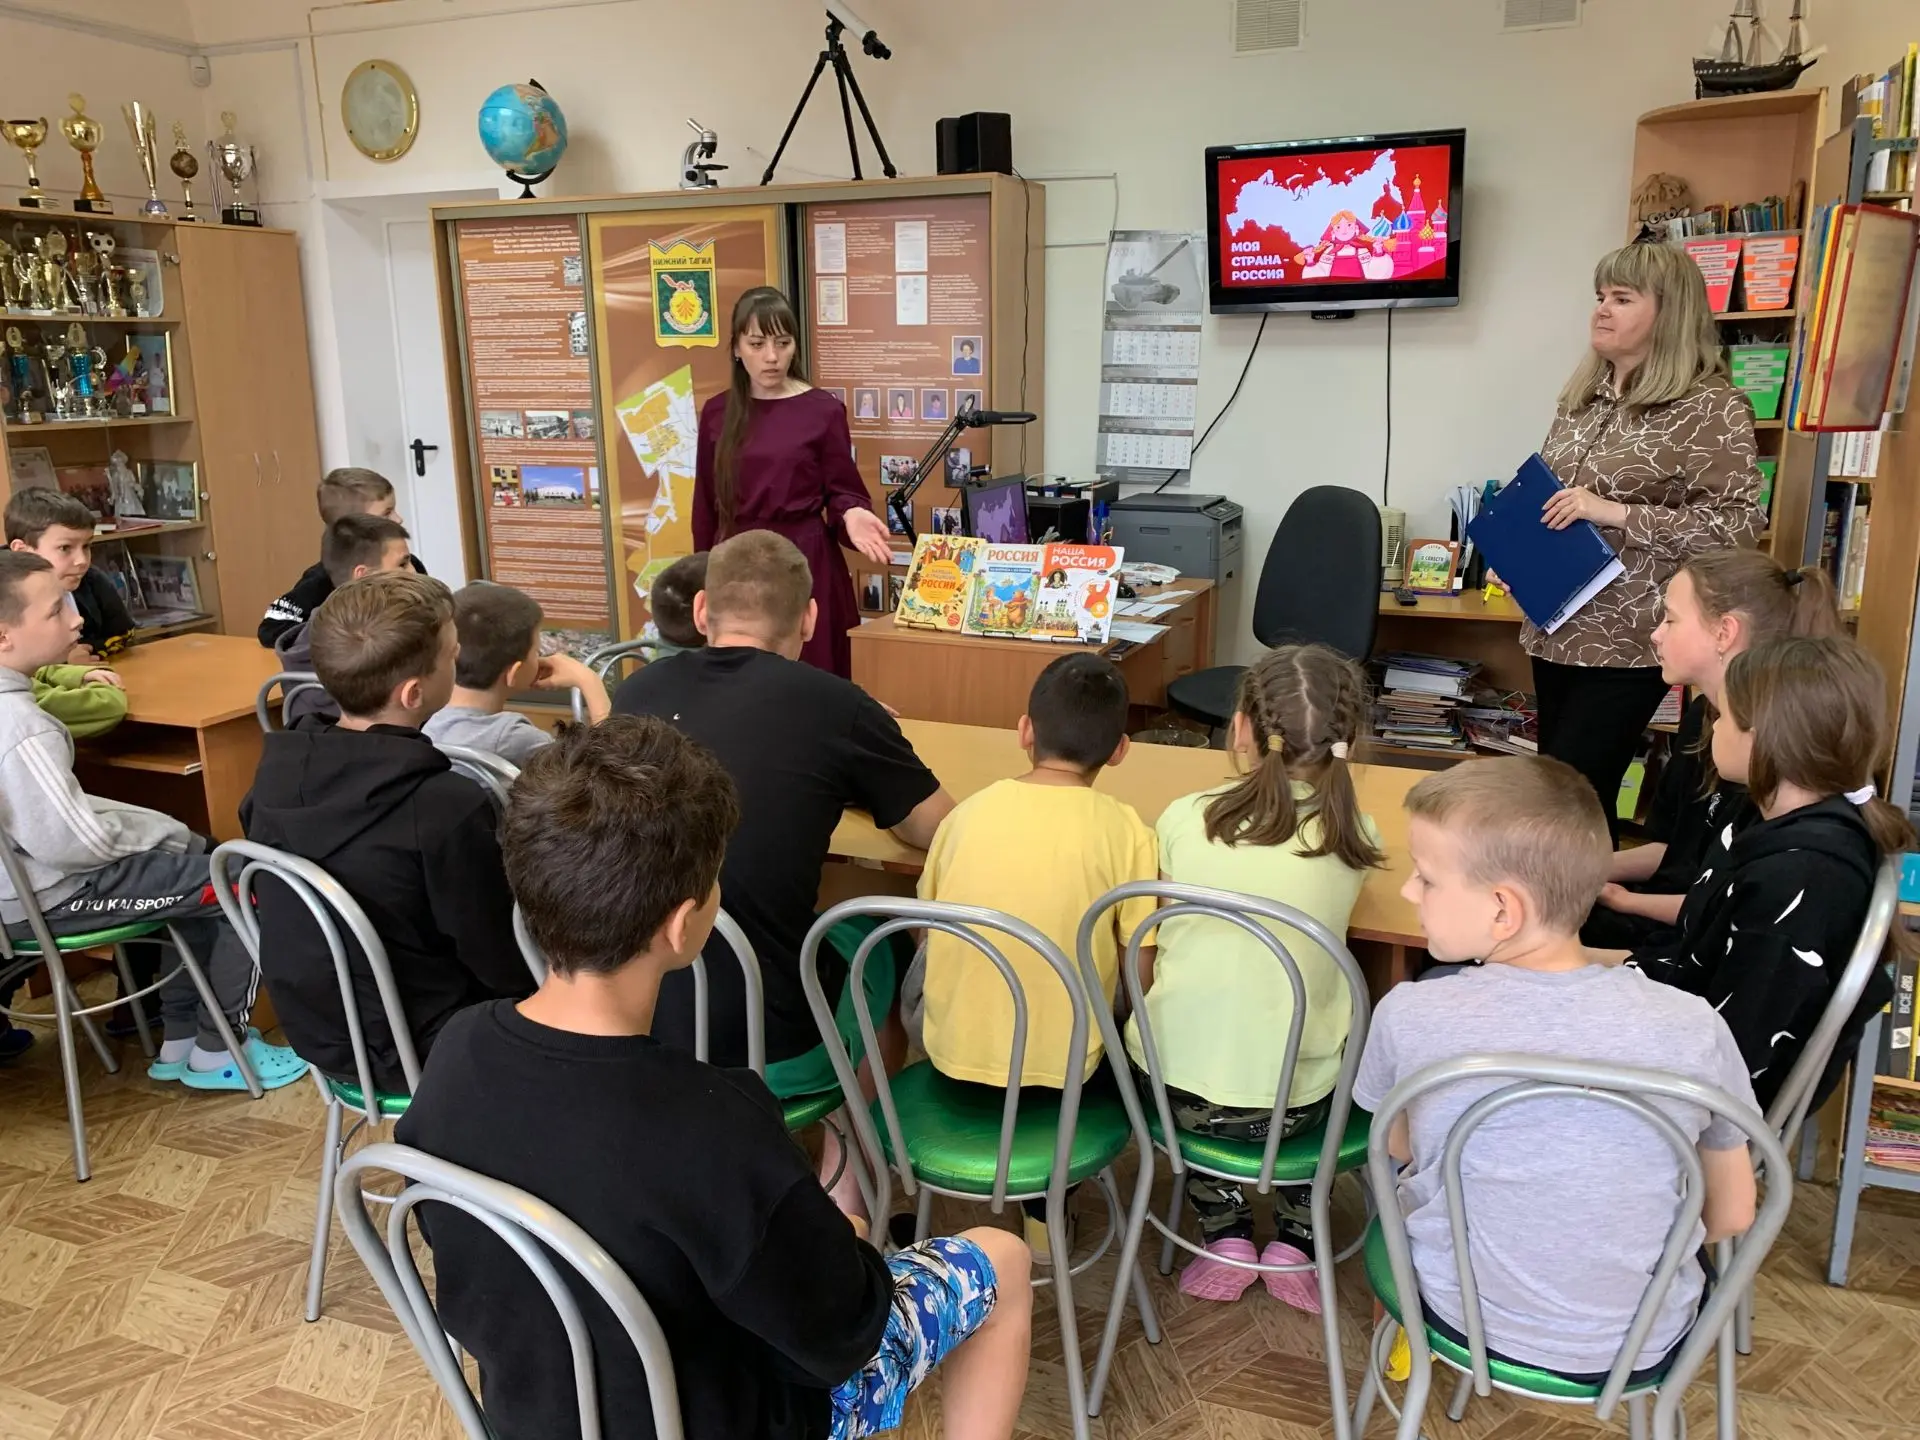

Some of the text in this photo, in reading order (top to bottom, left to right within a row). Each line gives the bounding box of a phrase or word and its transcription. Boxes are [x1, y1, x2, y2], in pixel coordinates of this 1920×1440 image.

[1231, 242, 1260, 252] МОЯ
[653, 256, 712, 266] НИЖНИЙ ТАГИЛ
[1231, 254, 1282, 267] СТРАНА
[1232, 269, 1284, 281] РОССИЯ
[987, 549, 1039, 562] РОССИЯ
[1053, 547, 1085, 556] НАША
[1051, 555, 1107, 568] РОССИЯ
[921, 578, 956, 590] РОССИИ
[134, 895, 184, 911] SPORT
